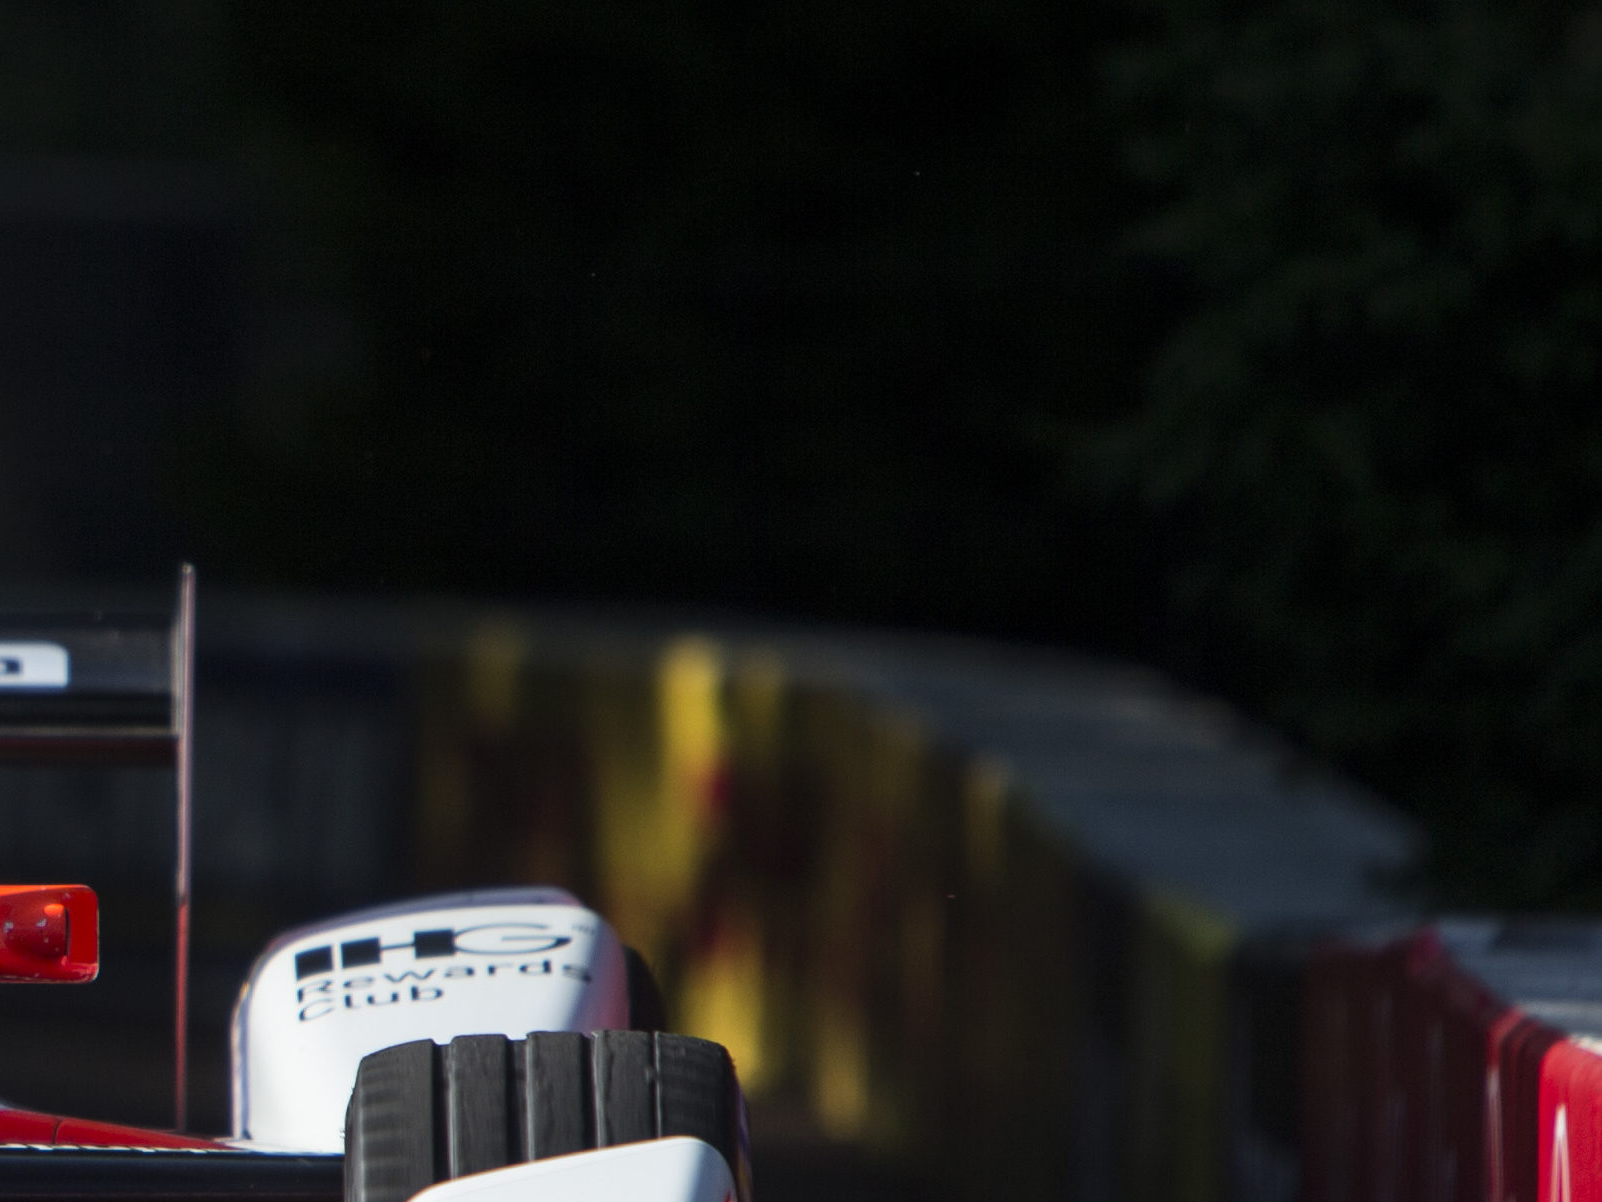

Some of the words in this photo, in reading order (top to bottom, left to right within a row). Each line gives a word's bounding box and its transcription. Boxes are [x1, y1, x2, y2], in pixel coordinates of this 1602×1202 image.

[296, 922, 572, 980] IHG
[297, 959, 593, 1004] Rewards
[298, 984, 445, 1023] Club
